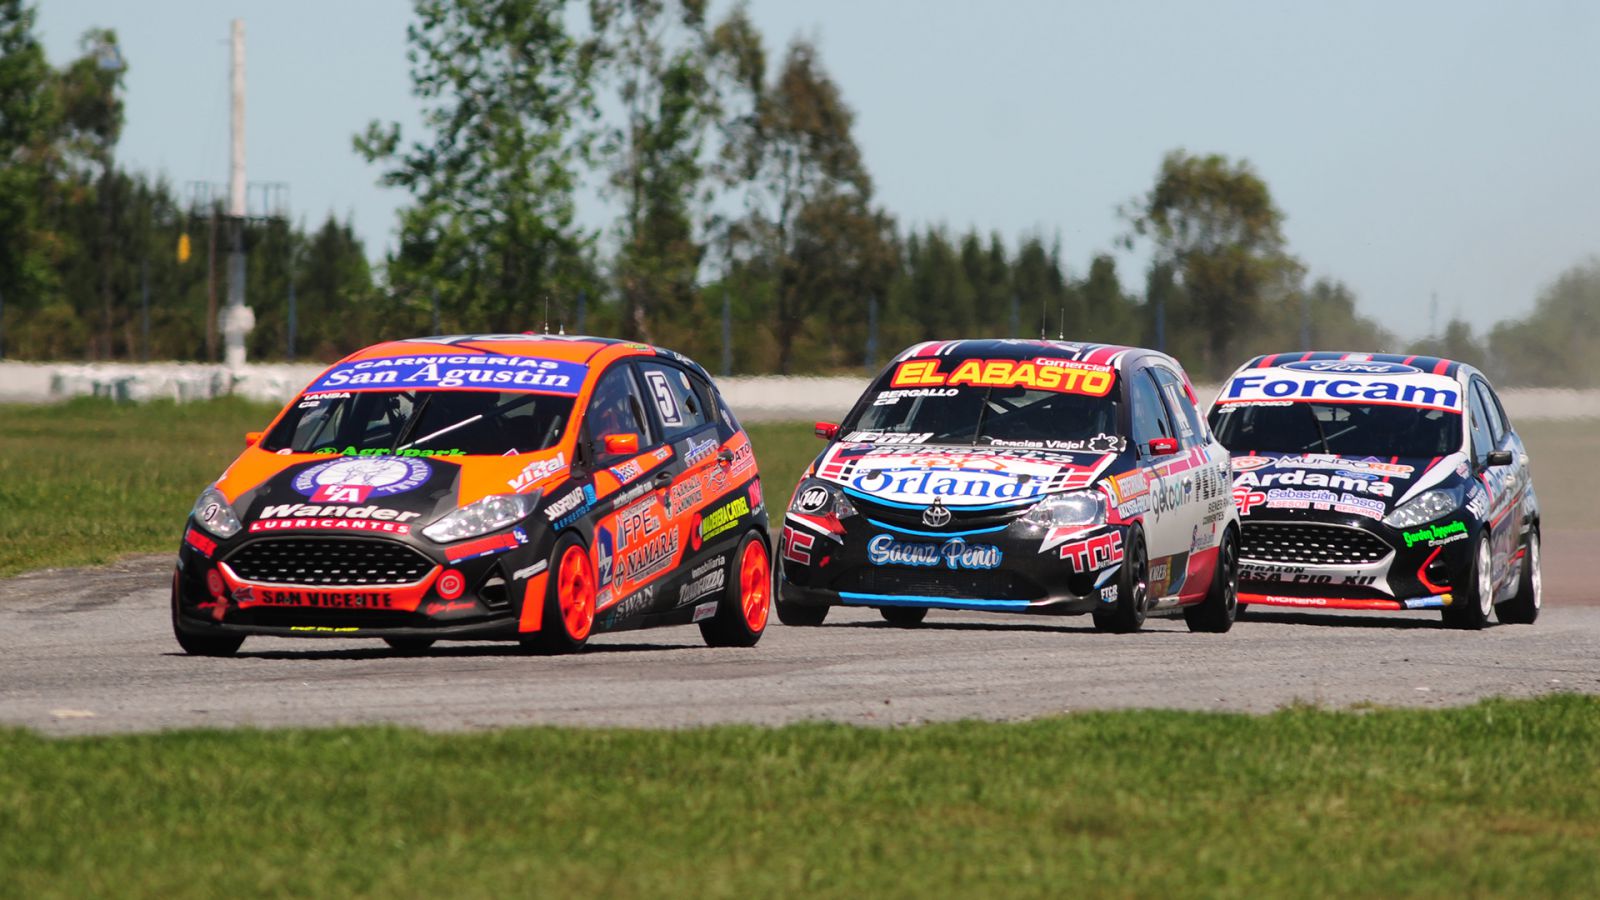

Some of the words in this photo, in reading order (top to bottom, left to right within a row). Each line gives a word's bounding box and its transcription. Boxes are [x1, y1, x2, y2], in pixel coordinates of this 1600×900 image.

[354, 355, 559, 370] CARNICERÍAS
[1036, 358, 1111, 373] Comercial
[1311, 361, 1392, 373] Ford
[322, 368, 399, 387] San
[402, 362, 571, 388] Agustin
[894, 361, 945, 385] EL
[949, 361, 1112, 394] ABASTO
[651, 375, 675, 419] 5
[877, 388, 960, 400] BERGALLO
[1228, 375, 1458, 408] Forcam
[341, 446, 468, 457] Agrpark
[990, 439, 1044, 448] Gracias
[1046, 440, 1085, 450] Viejo!
[852, 470, 1043, 499] Orlandi
[1232, 470, 1395, 498] Ardama
[803, 491, 826, 507] 144
[1266, 499, 1310, 509] ASESOR
[1314, 501, 1330, 510] DE
[259, 503, 422, 522] Wander
[251, 519, 410, 534] LUBRICANTES
[623, 507, 652, 547] FPE
[868, 535, 940, 565] Saenz
[941, 537, 1002, 569] Peña
[1060, 529, 1124, 574] TMC
[1237, 569, 1283, 582] ASA
[1292, 572, 1332, 585] PIO
[262, 590, 302, 606] SAN
[307, 592, 392, 608] VICENTE
[1266, 595, 1327, 606] MORENO
